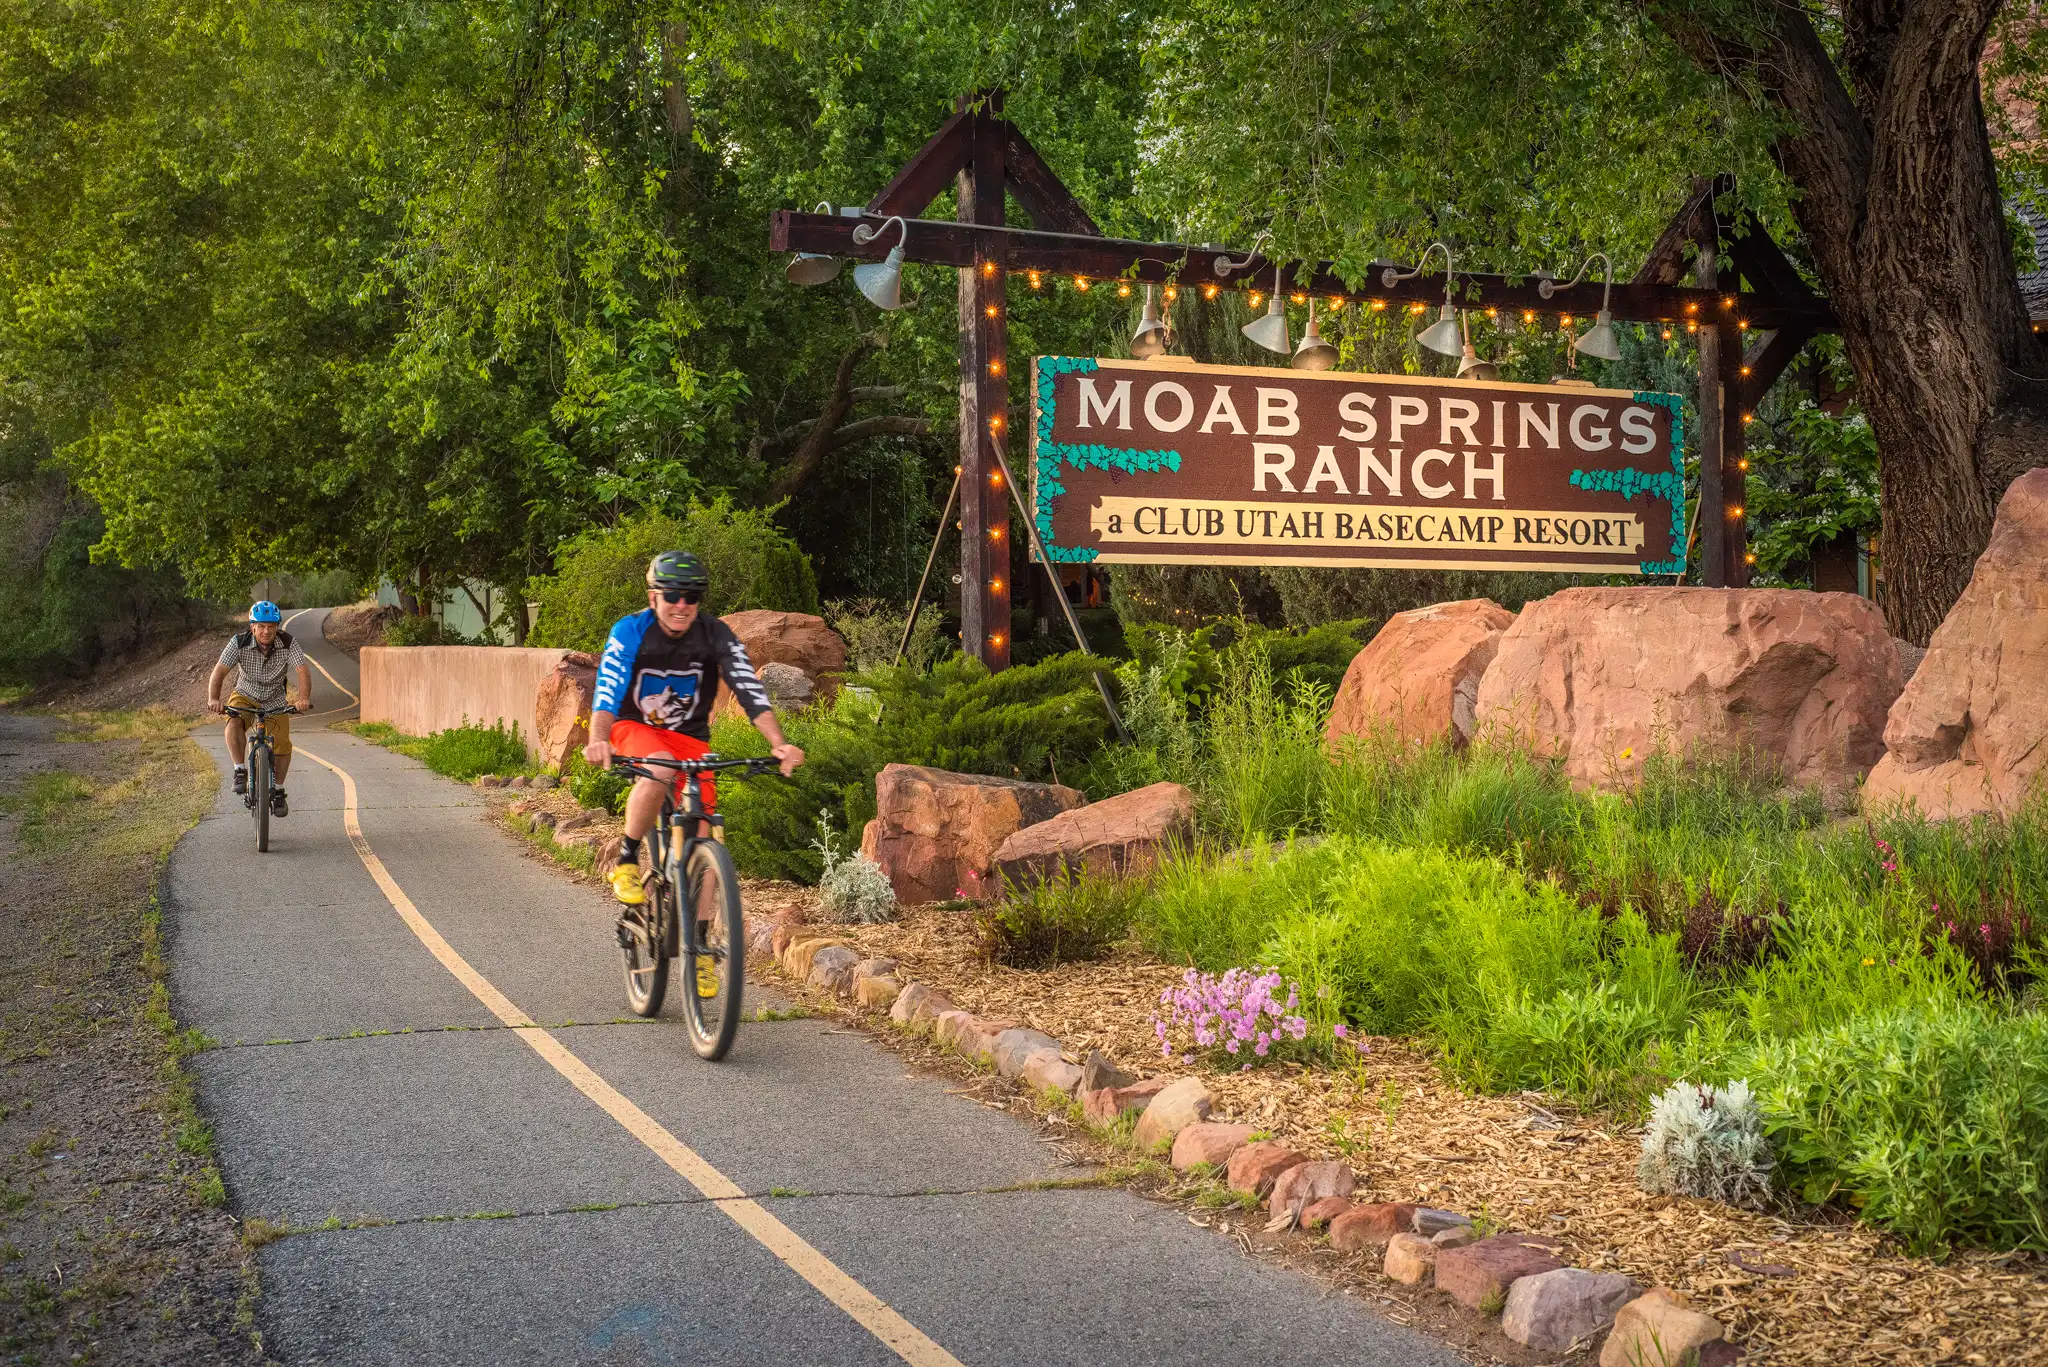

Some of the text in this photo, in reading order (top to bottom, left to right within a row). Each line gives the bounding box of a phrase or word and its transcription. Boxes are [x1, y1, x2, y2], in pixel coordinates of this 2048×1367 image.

[1076, 377, 1657, 454] MOAB SPRINGS
[1251, 442, 1506, 500] RANCH
[1107, 506, 1631, 547] a CLUB UTAH BASECAMP RESORT
